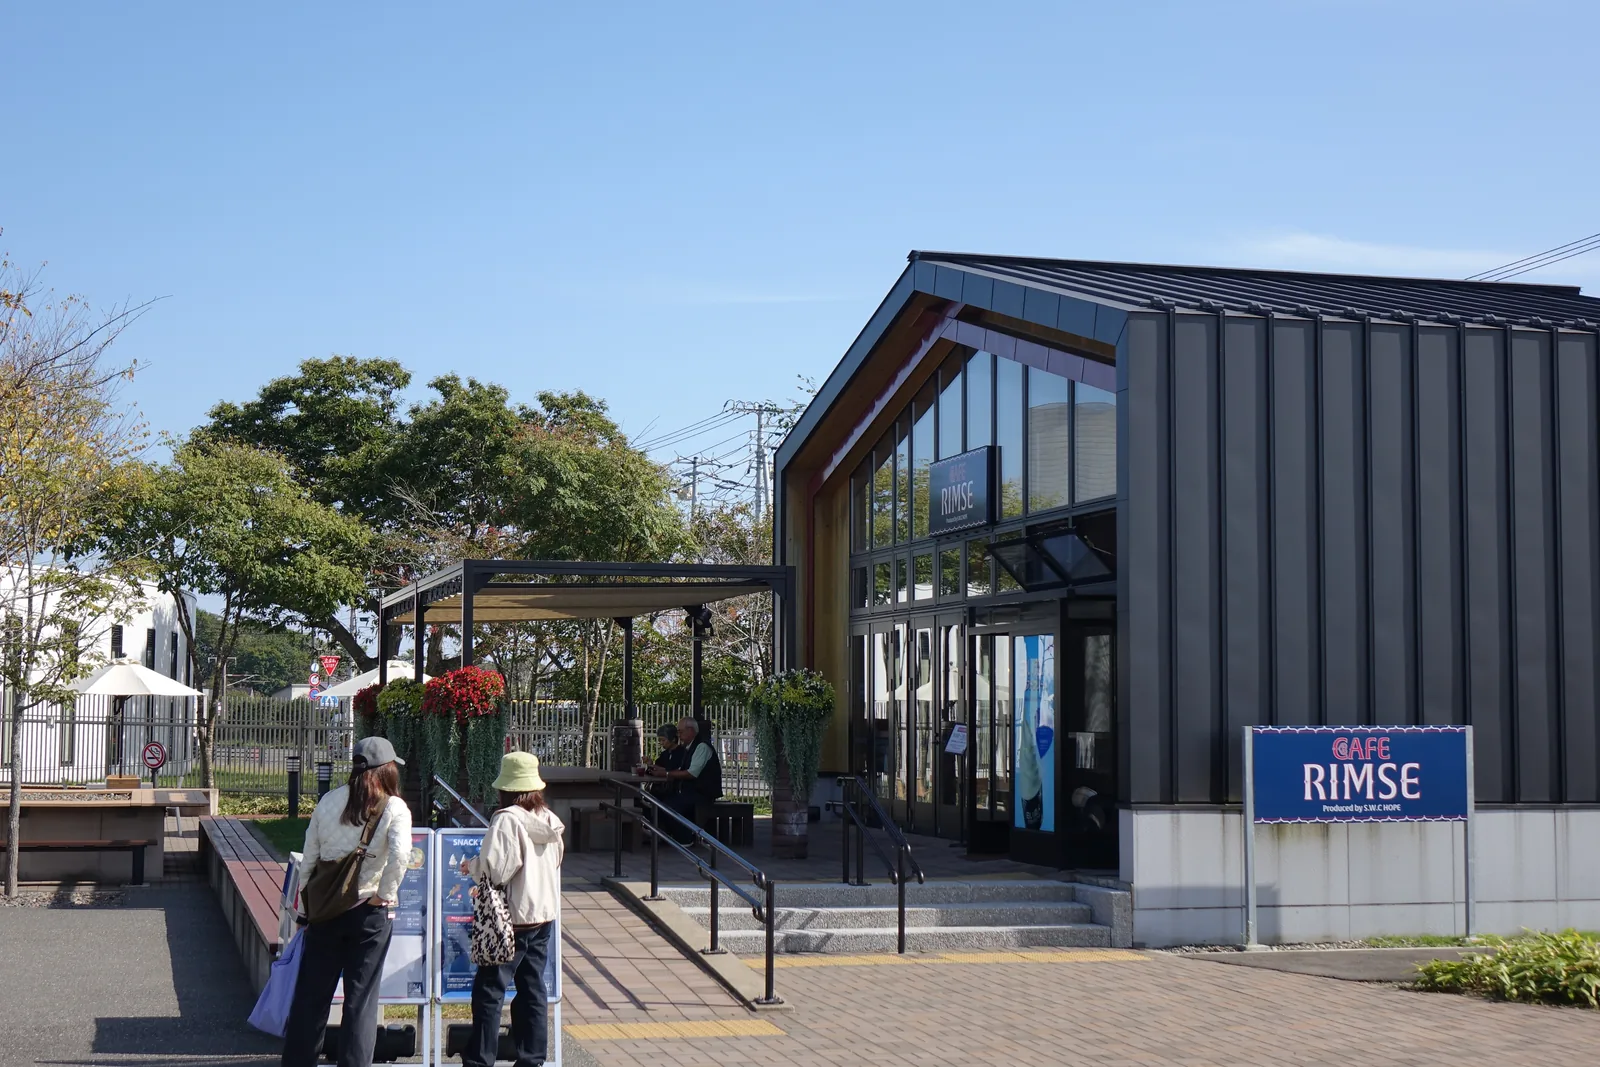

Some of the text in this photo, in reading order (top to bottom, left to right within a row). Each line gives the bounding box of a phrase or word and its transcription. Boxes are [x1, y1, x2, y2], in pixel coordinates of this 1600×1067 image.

[941, 480, 974, 516] RIMSE
[1332, 736, 1391, 760] CAFE
[1303, 762, 1421, 800] RIMSE
[1322, 803, 1402, 813] Produced by S.W.C HOPE
[453, 838, 479, 846] SNACK
